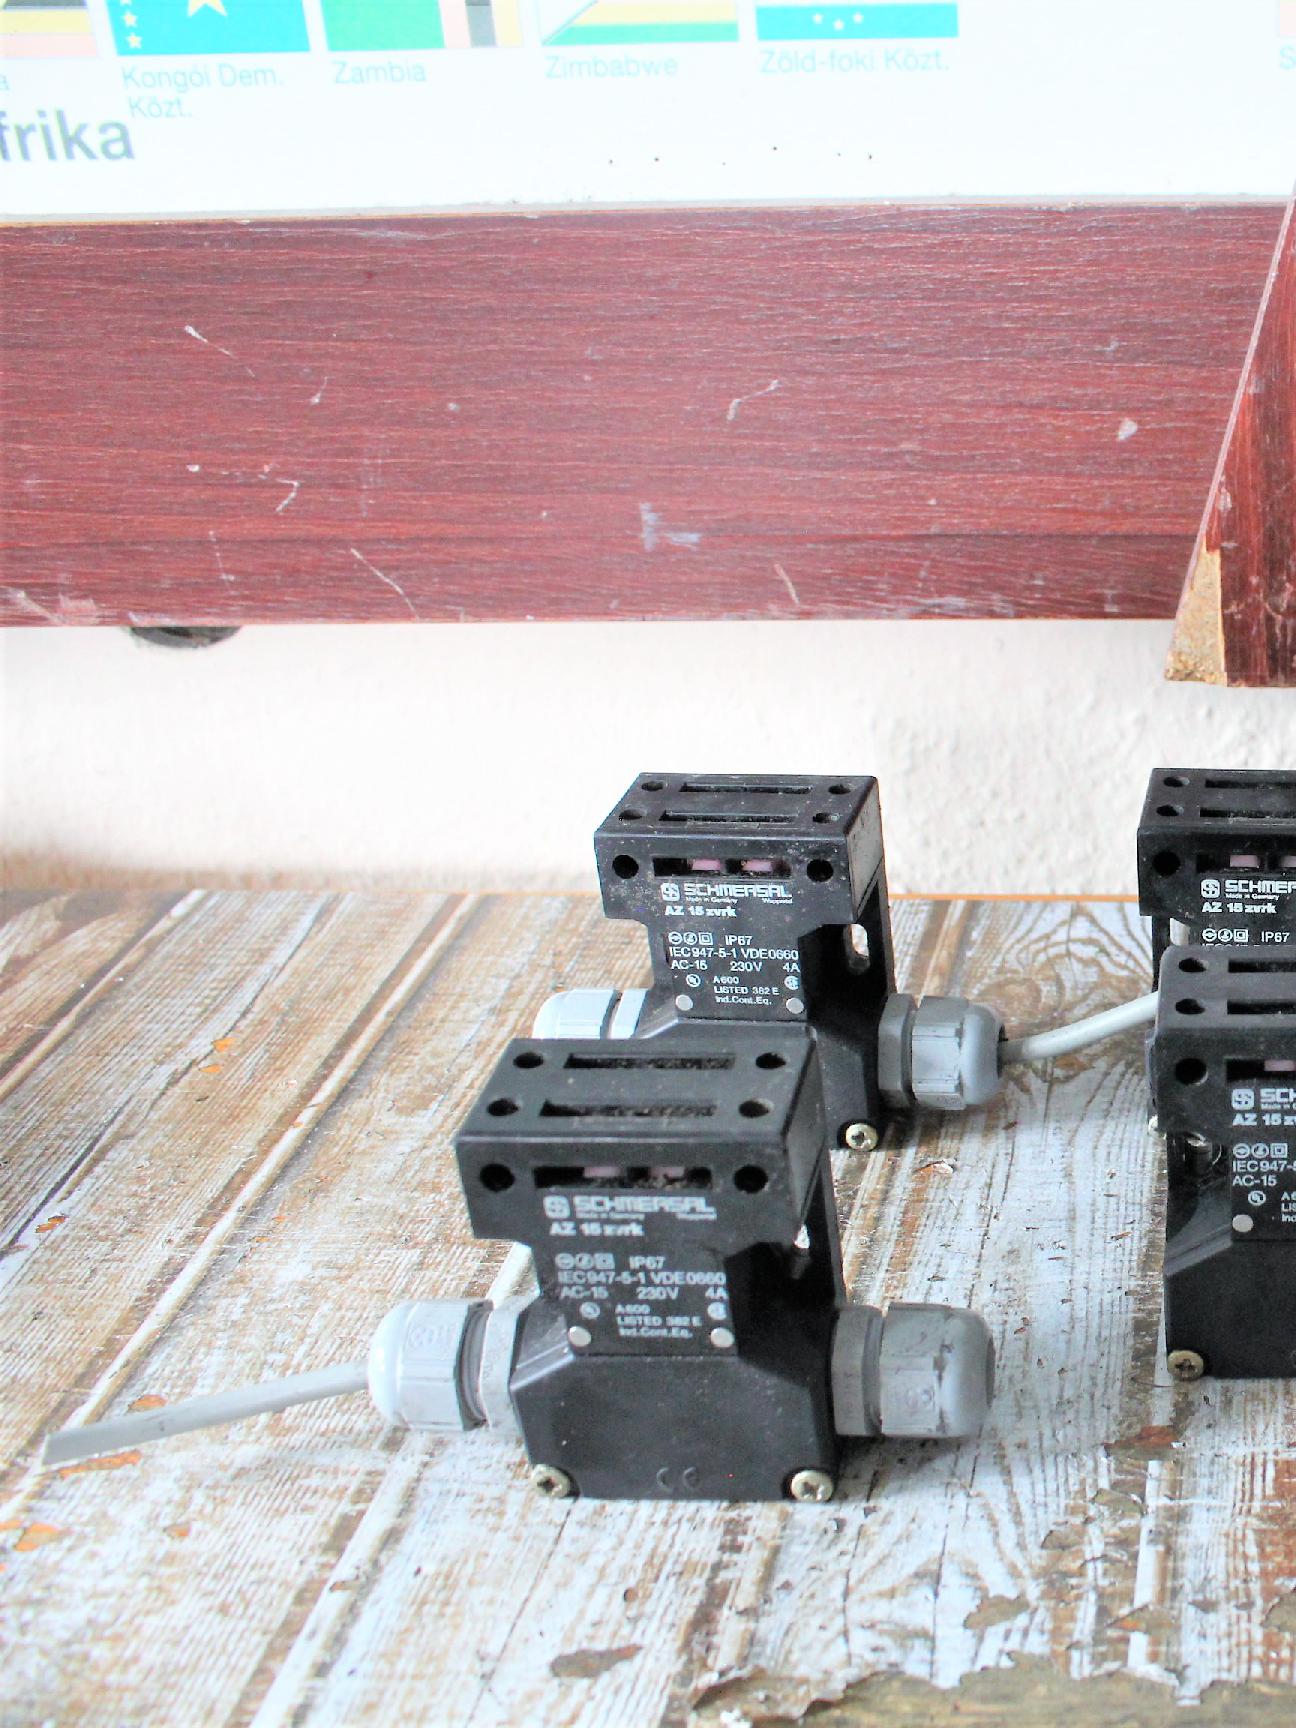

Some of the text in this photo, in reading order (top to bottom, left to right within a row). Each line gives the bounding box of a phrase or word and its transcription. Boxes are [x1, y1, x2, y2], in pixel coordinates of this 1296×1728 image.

[760, 48, 950, 74] Zöld-foki Közt.
[331, 60, 427, 84] Zambia
[545, 55, 678, 80] Zimbabwe
[121, 63, 285, 93] Kongói Dem.
[128, 97, 193, 118] Közt.
[684, 883, 793, 898] SCHMERSAL
[665, 906, 684, 916] AZ
[1202, 902, 1222, 913] AZ
[725, 935, 753, 945] IP67
[1261, 931, 1290, 942] IP67
[671, 960, 708, 970] AC-15
[783, 961, 800, 972] 4A
[714, 986, 749, 994] LISTED
[1232, 1114, 1257, 1125] AZ
[1232, 1175, 1277, 1186] AC-15
